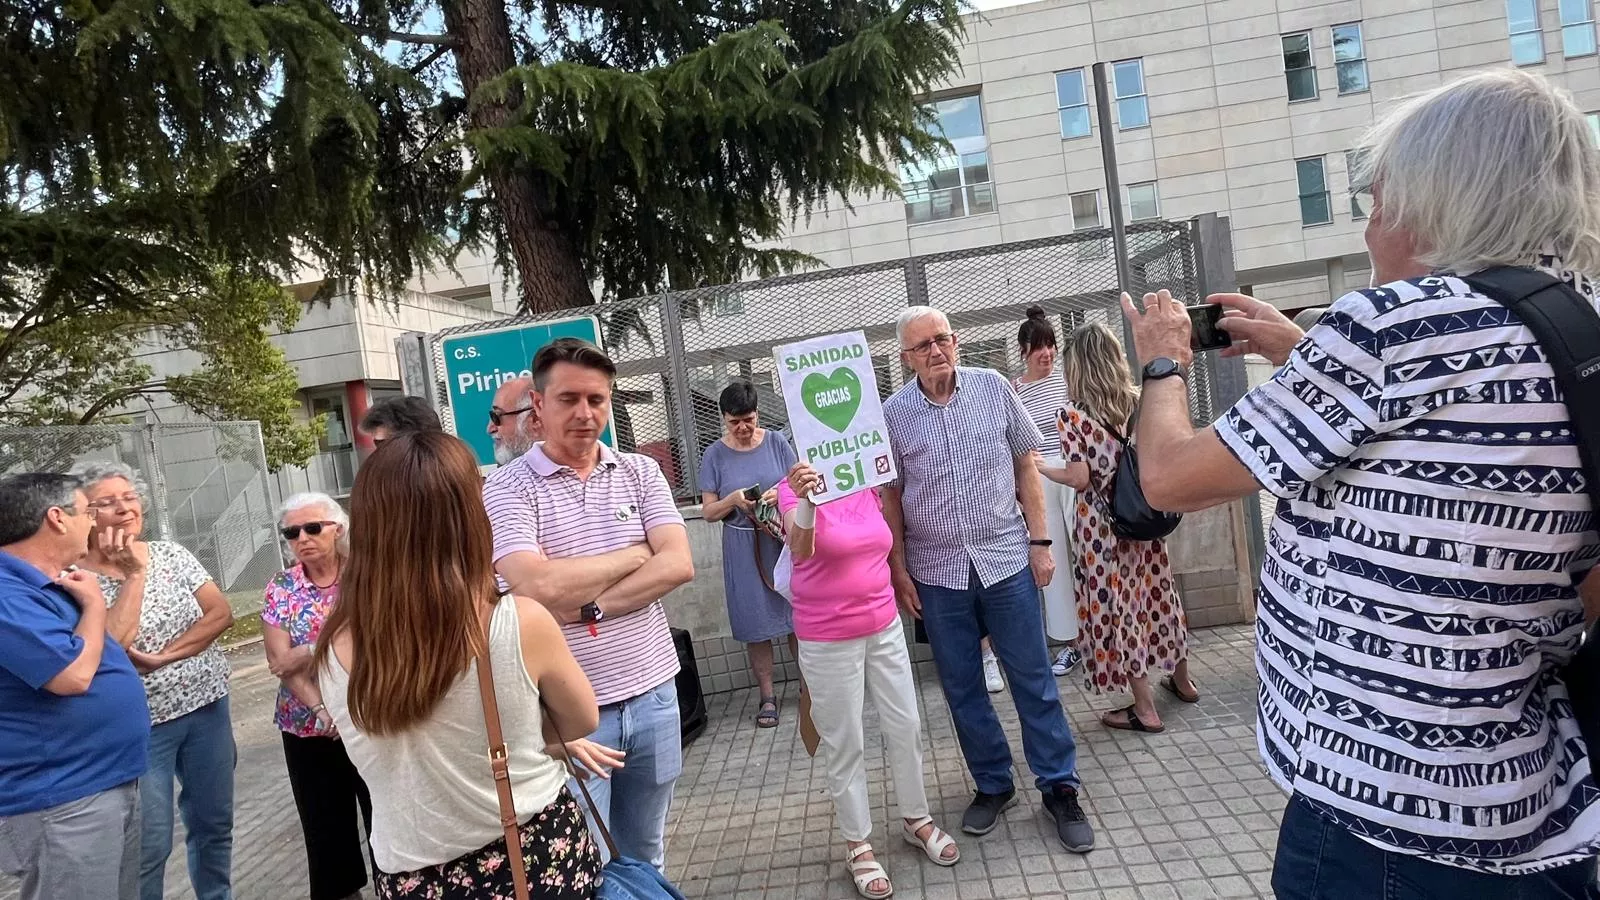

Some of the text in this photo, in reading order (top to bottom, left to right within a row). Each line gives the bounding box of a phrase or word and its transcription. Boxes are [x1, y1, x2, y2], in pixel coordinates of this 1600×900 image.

[454, 346, 481, 360] C.S.
[785, 343, 864, 372] SANIDAD
[1582, 360, 1600, 377] UKO
[814, 386, 851, 409] GRACIAS
[806, 430, 884, 464] PÚBLICA
[833, 452, 867, 492] SÍ
